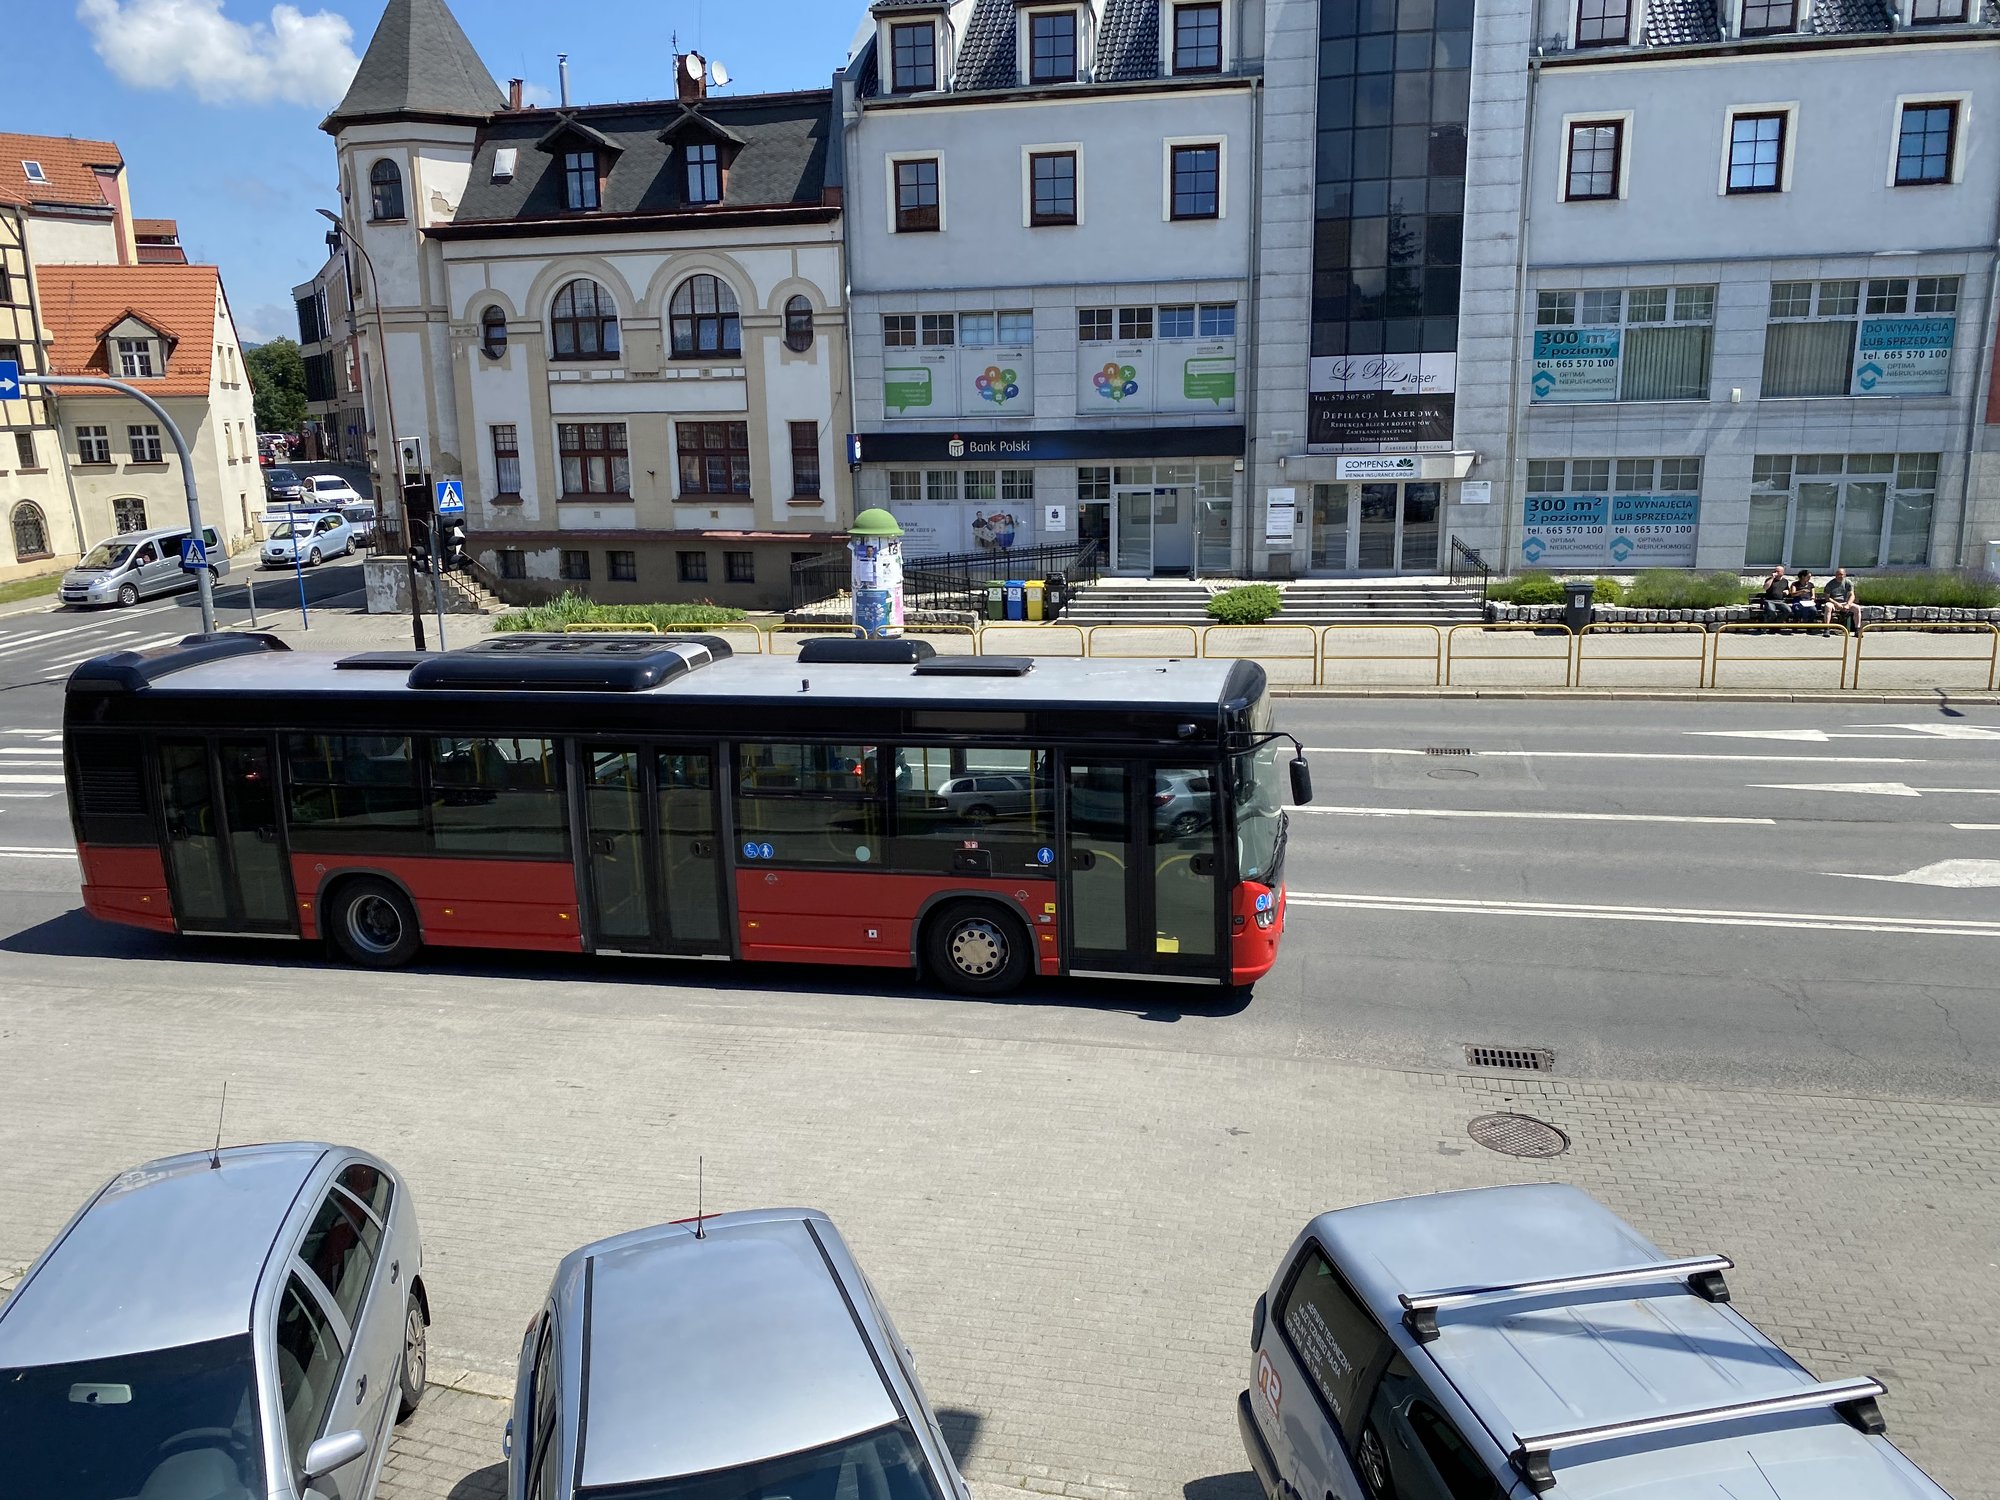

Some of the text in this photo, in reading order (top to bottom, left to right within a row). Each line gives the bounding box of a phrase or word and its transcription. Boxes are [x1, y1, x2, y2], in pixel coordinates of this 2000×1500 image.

[1866, 324, 1882, 333] DO
[1540, 332, 1579, 345] 300
[1863, 338, 1883, 346] LUB
[1539, 346, 1611, 357] 2 poziomy
[1863, 350, 1947, 360] tel. 665 570 100
[1537, 359, 1614, 369] tel. 665 570 100
[1407, 373, 1437, 383] laser
[970, 441, 997, 452] Bank
[1000, 440, 1030, 452] Polski
[1345, 461, 1395, 469] COMPENSA
[1528, 499, 1566, 512] 300
[1616, 501, 1631, 509] DO
[1528, 512, 1600, 524] 2 poziomy
[1614, 513, 1633, 521] LUB
[1527, 526, 1603, 535] tel. 665 570 100
[1615, 525, 1692, 534] tel. 665 570 100
[1323, 1327, 1353, 1375] TECHNICZNY
